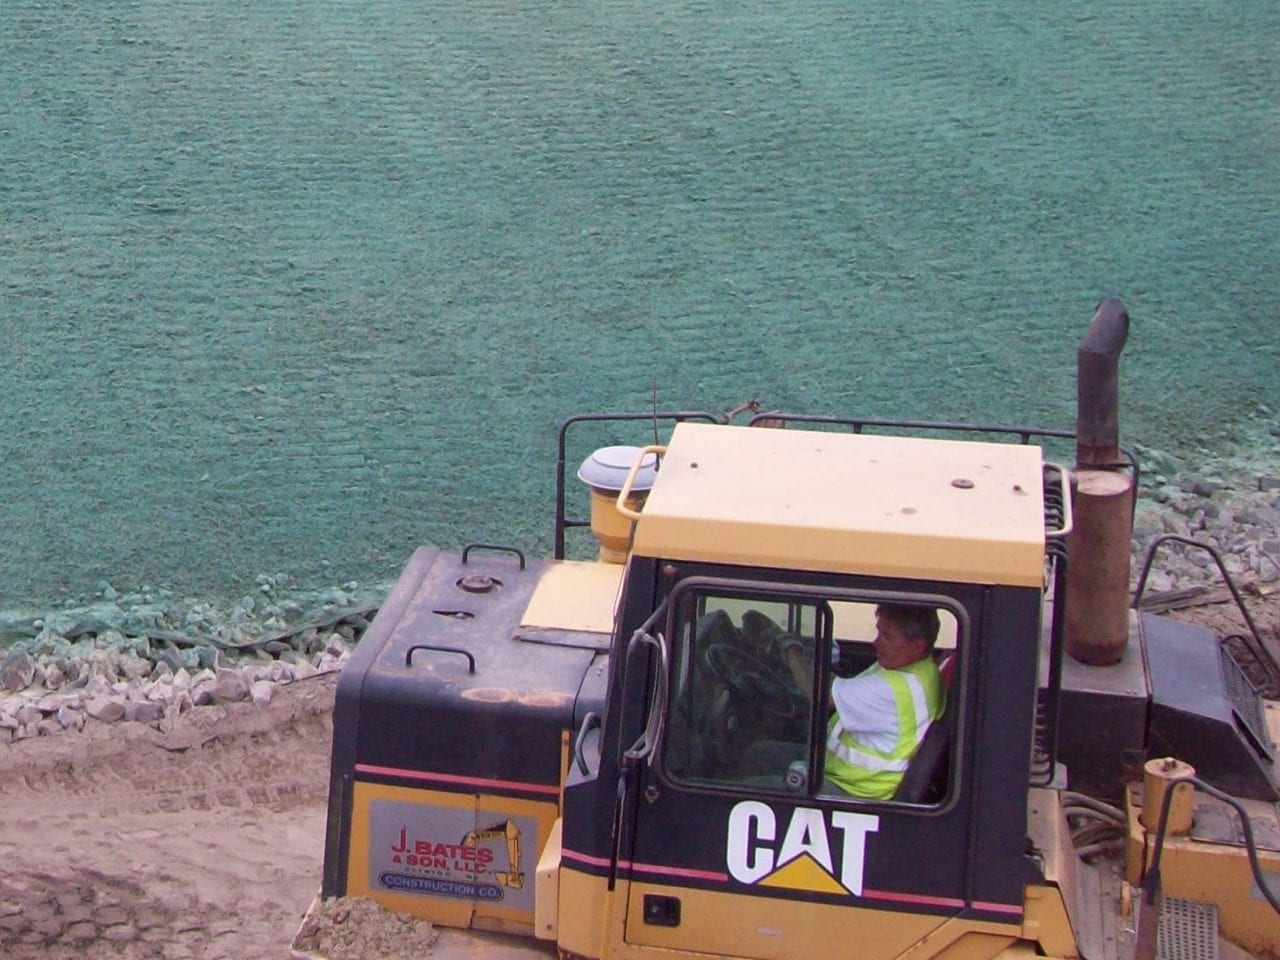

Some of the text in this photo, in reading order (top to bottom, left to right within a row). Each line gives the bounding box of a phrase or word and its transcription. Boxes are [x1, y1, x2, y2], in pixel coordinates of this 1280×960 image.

[415, 840, 493, 863] BATES
[726, 800, 879, 897] CAT
[385, 875, 475, 895] CONSTRUCTION
